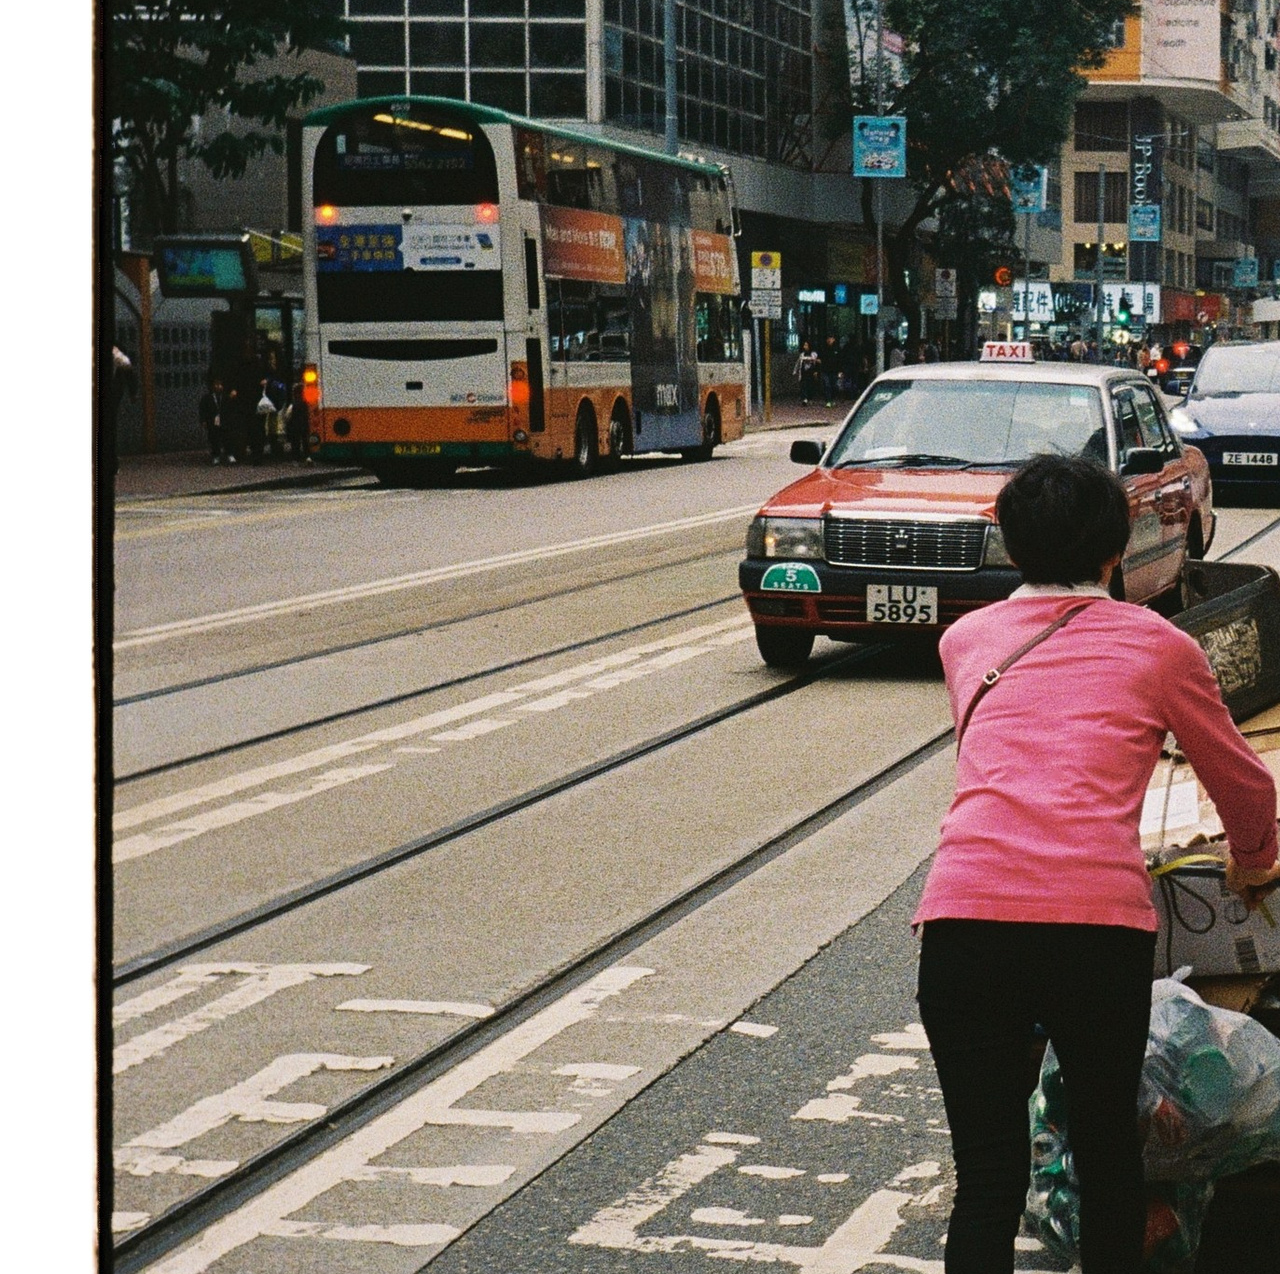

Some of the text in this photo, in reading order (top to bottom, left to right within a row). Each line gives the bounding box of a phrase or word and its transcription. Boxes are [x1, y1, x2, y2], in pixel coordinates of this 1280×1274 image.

[1134, 134, 1153, 157] JP
[986, 344, 1026, 358] TAXI
[1227, 453, 1273, 464] ZE 1448
[785, 570, 797, 582] 5
[773, 581, 809, 591] SEATS
[887, 586, 918, 604] LU
[873, 603, 932, 623] 5895
